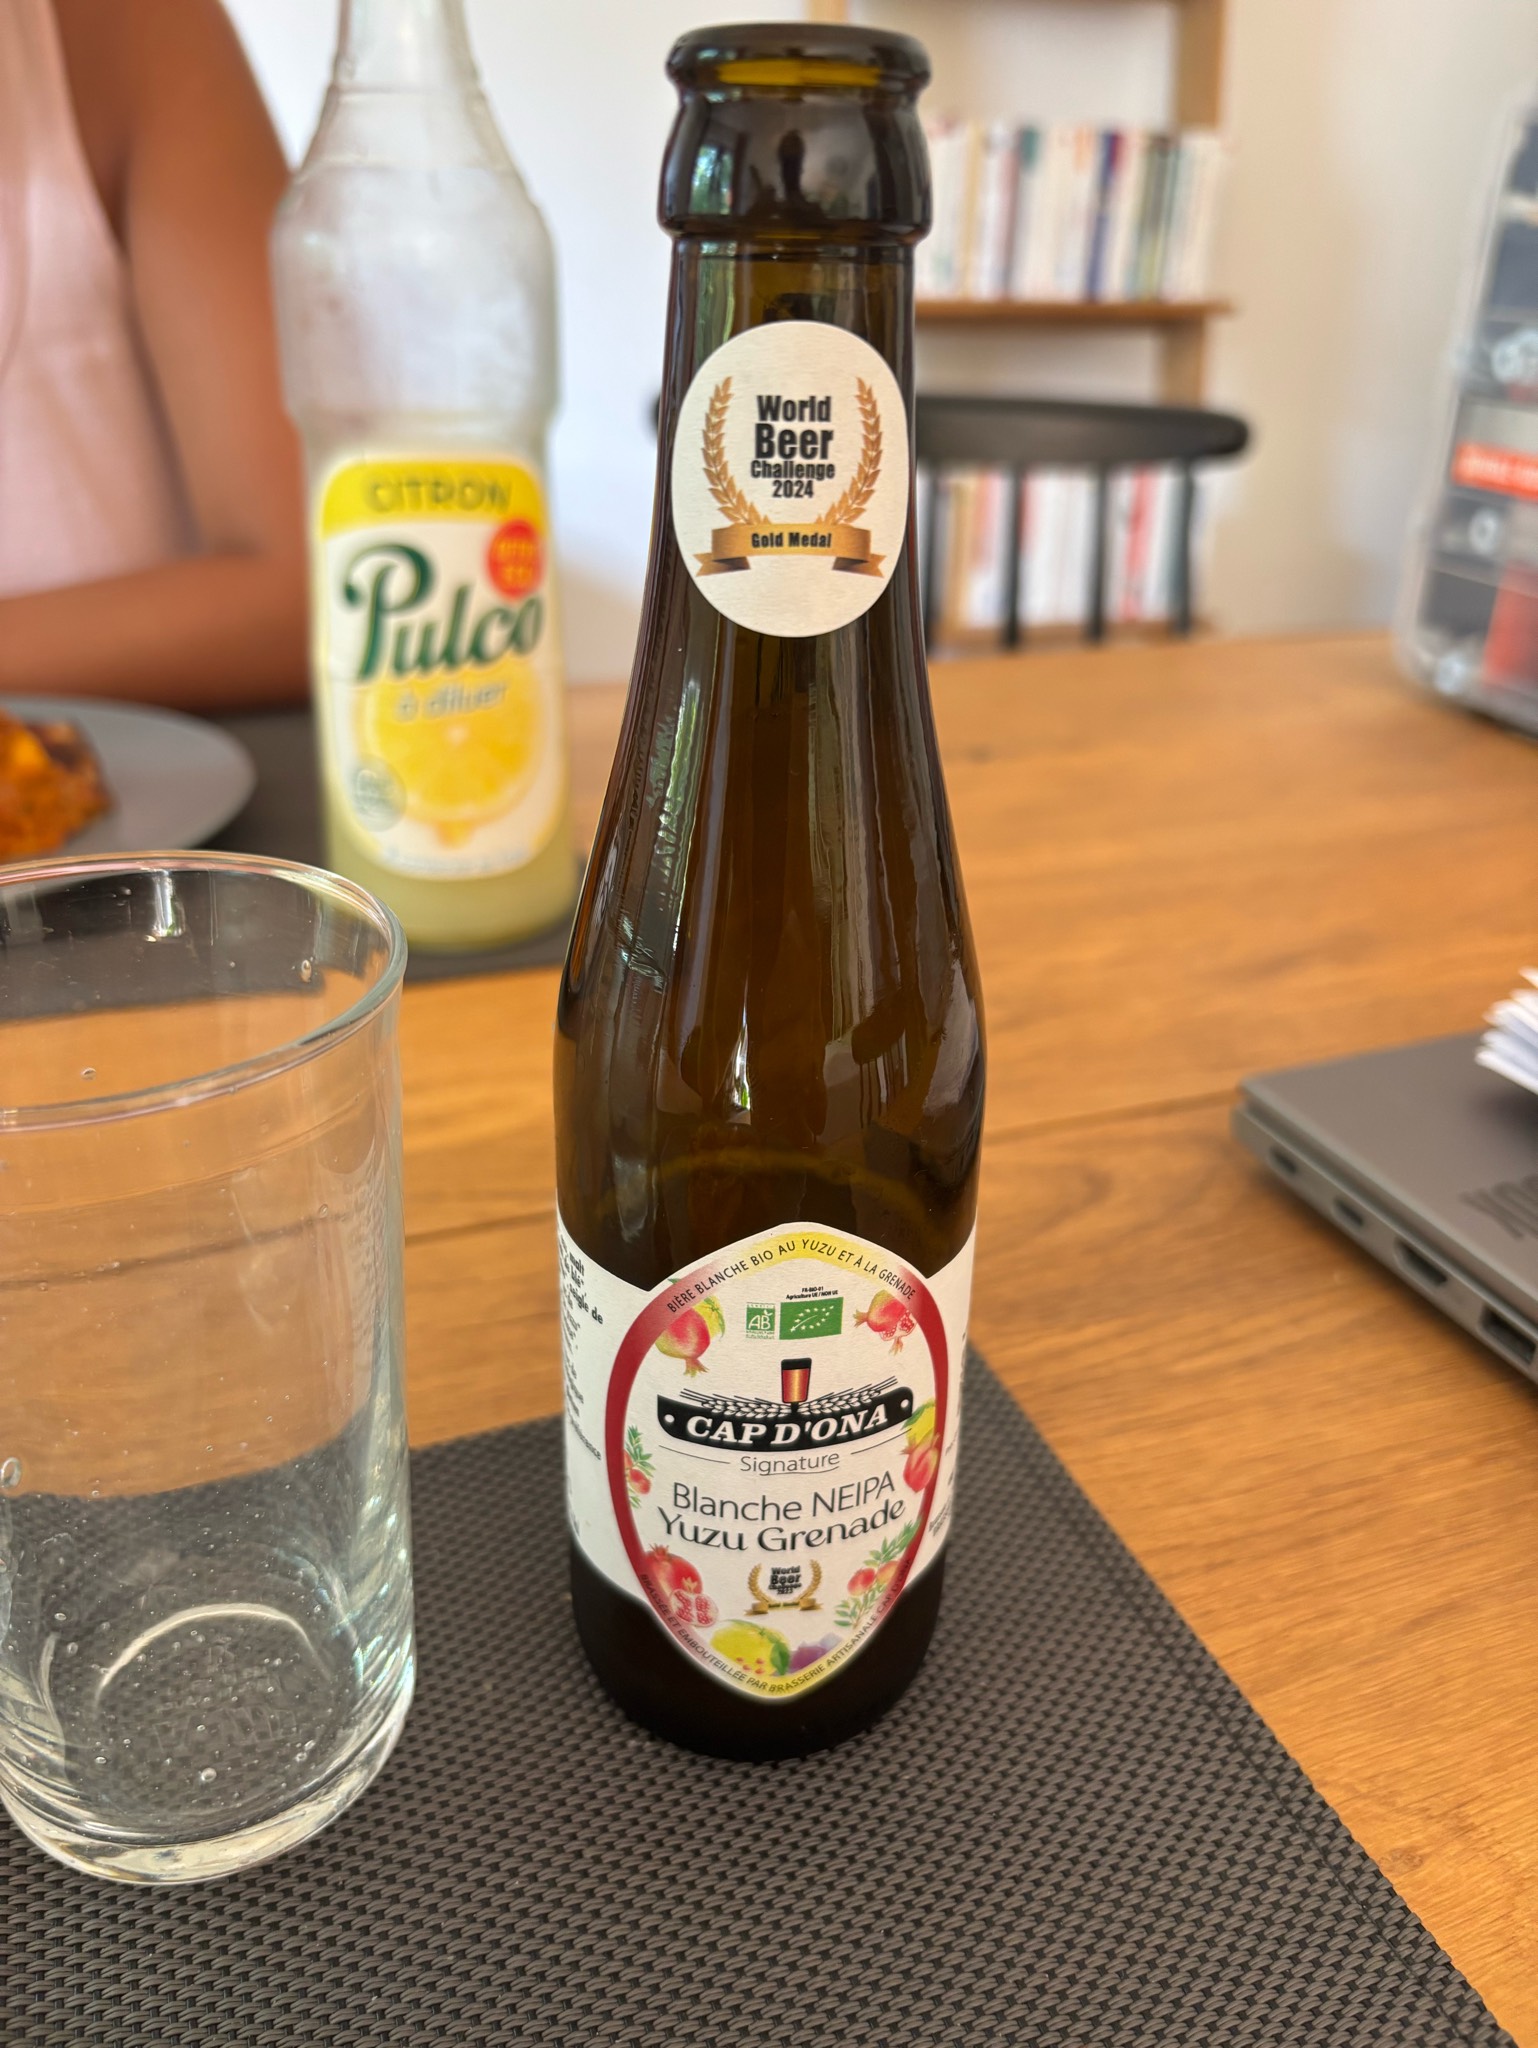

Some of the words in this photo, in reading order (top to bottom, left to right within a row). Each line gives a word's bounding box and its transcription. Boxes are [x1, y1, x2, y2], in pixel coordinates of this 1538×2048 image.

[756, 395, 832, 423] World
[755, 423, 834, 460] Beer
[750, 460, 836, 481] Challenge
[367, 480, 512, 513] CITRON
[772, 479, 814, 499] 2024
[751, 533, 783, 548] Gold
[788, 532, 832, 549] Medal
[342, 543, 545, 684] Pulco
[667, 1289, 696, 1313] BIÈRE
[694, 1260, 749, 1294] BLANCHE
[750, 1250, 773, 1266] BIO
[778, 1240, 796, 1256] AU
[802, 1239, 837, 1256] YUZU
[837, 1249, 855, 1263] ET
[853, 1255, 865, 1268] À
[863, 1260, 878, 1275] LA
[878, 1268, 916, 1300] GRENADE
[591, 1305, 604, 1325] de
[748, 1313, 772, 1330] AB
[686, 1414, 768, 1445] CAP
[770, 1403, 889, 1445] D'ONA
[740, 1453, 840, 1476] Signature
[673, 1481, 803, 1521] Blanche
[812, 1470, 896, 1518] NEIPA
[657, 1505, 748, 1551] Yuzu
[757, 1498, 906, 1552] Grenade
[770, 1574, 802, 1585] Beer
[771, 1565, 801, 1574] World
[667, 1615, 682, 1629] ET
[747, 1676, 768, 1691] PAR
[768, 1663, 826, 1693] BRASSERIE
[826, 1614, 877, 1667] ARTISANALE
